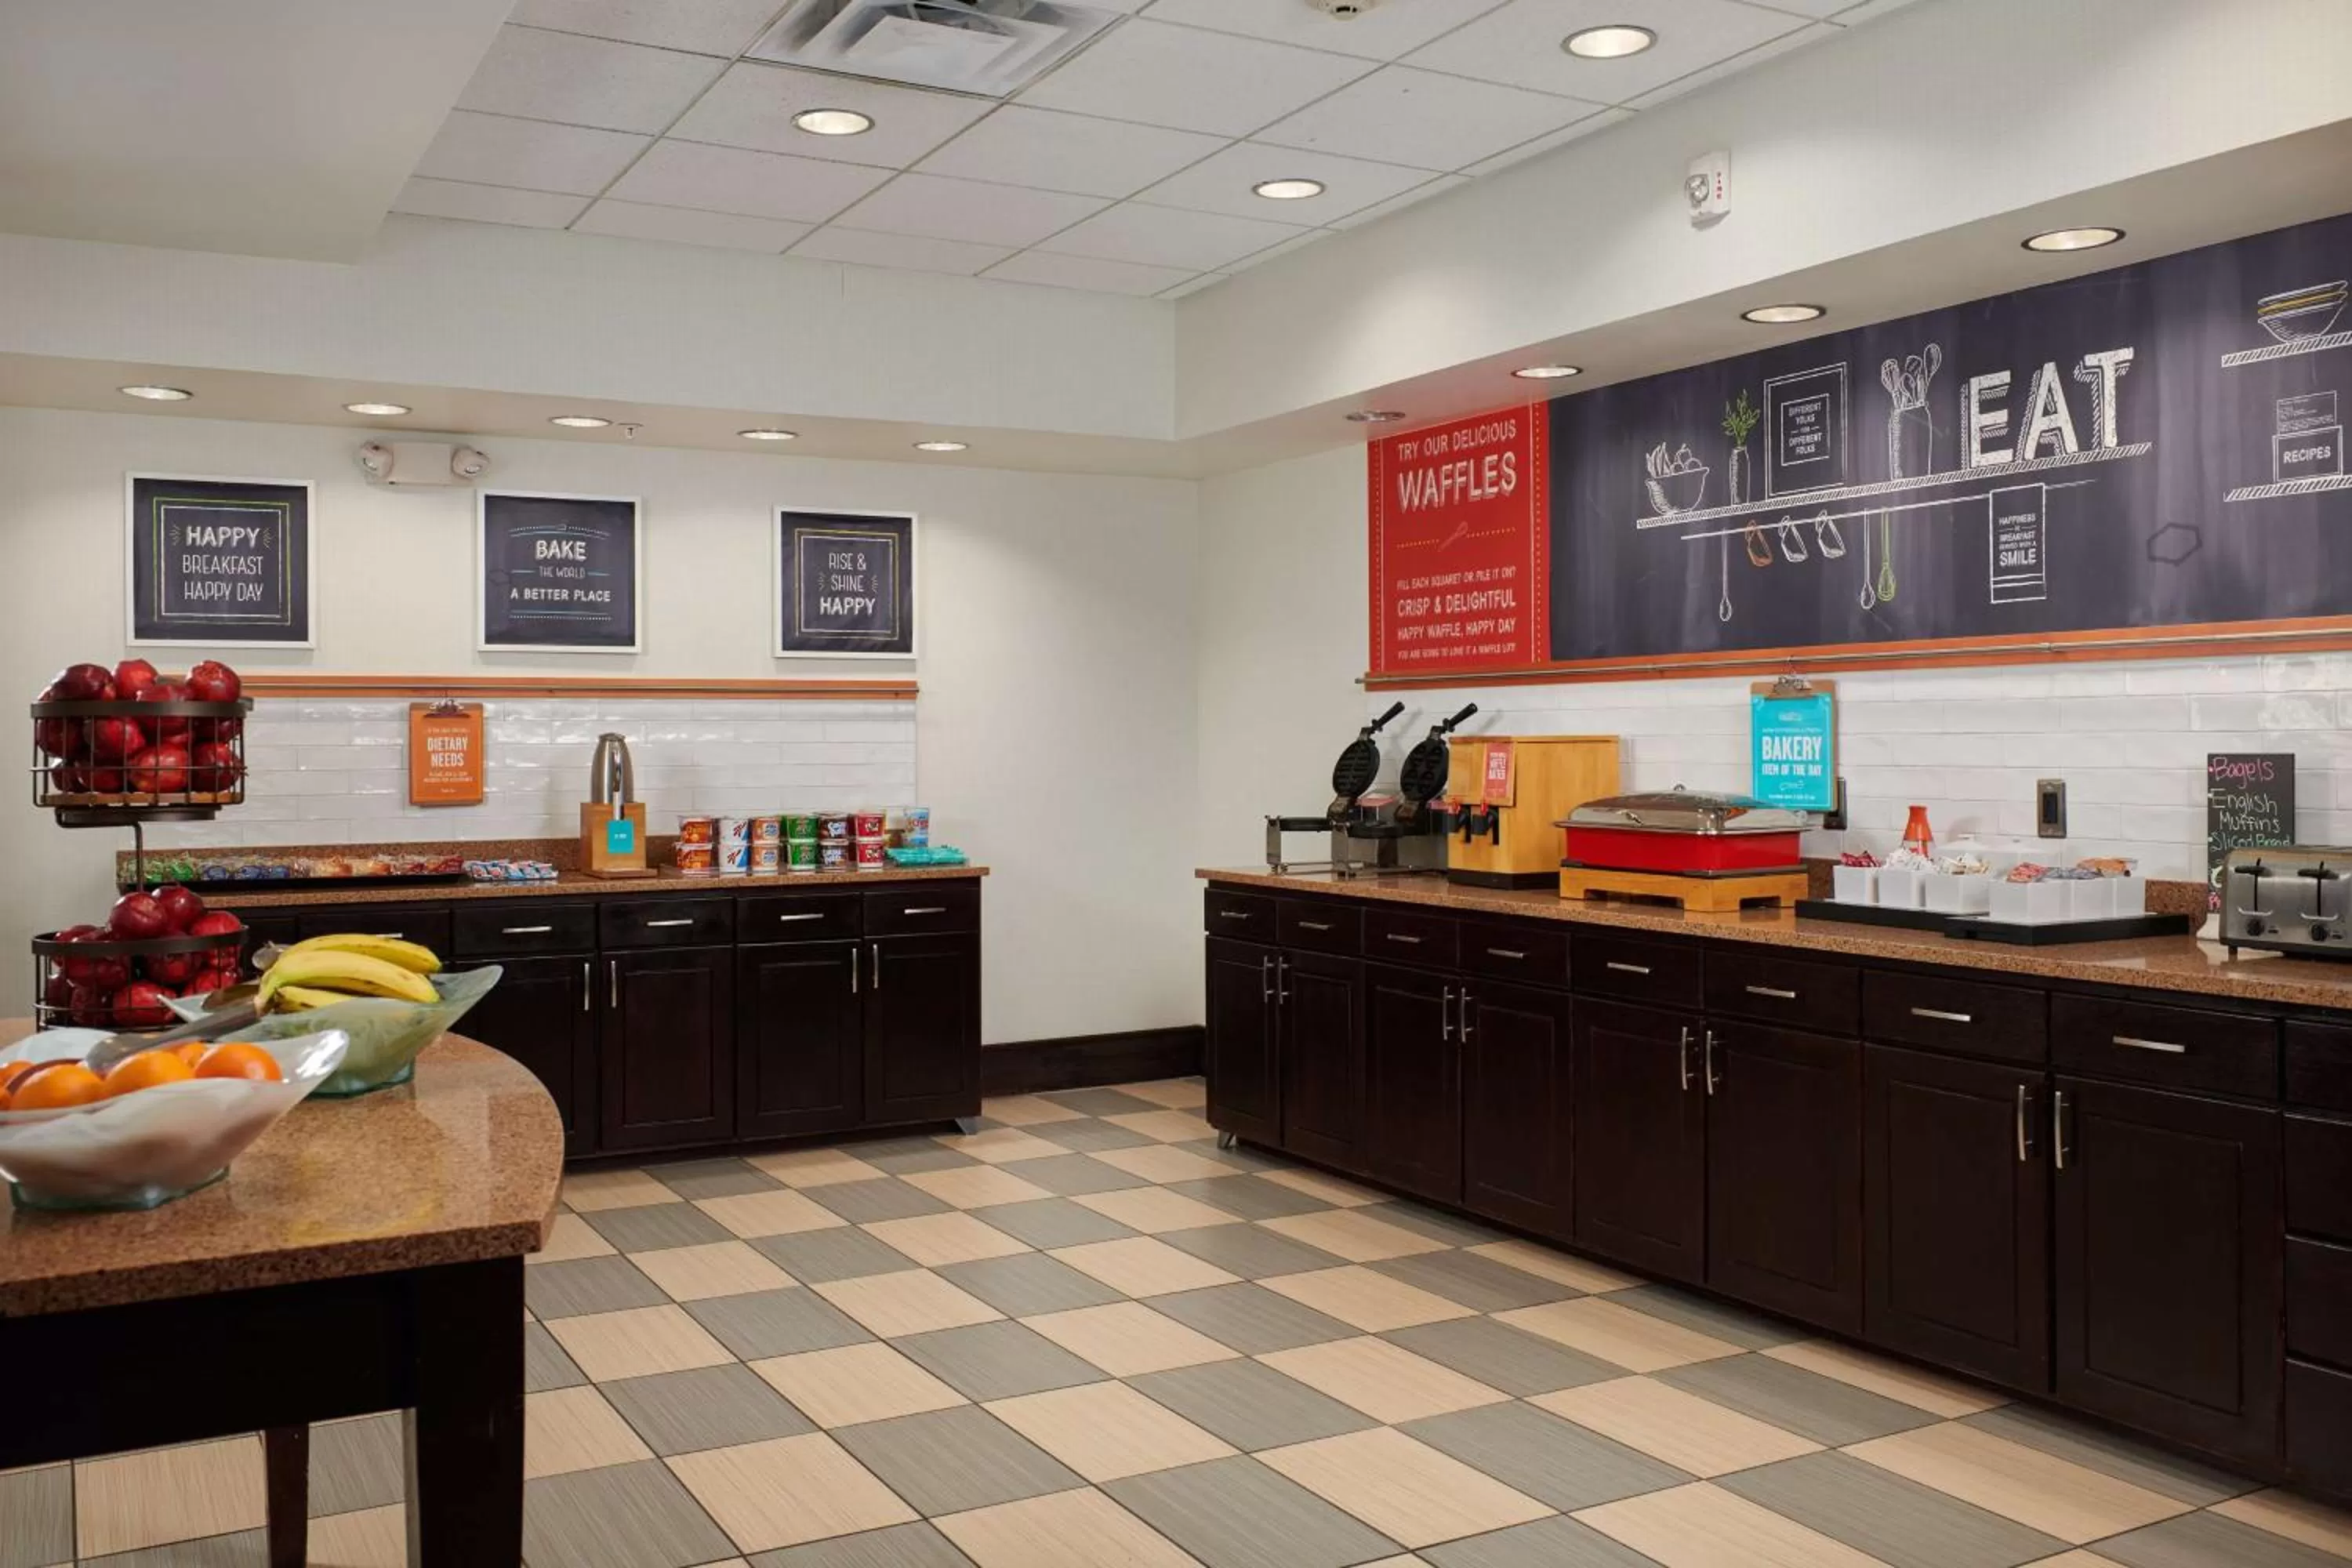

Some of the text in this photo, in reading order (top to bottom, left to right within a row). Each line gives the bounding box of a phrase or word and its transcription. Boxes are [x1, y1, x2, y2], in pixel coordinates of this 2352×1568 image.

[1962, 347, 2134, 470] EAT
[1398, 419, 1516, 461] TRY OUR DELICIOUS
[1788, 432, 1822, 447] DIFFERENT
[2283, 445, 2331, 464] RECIPES
[1398, 451, 1517, 514] WAFFLES
[1998, 513, 2036, 526] HAPPINESS
[186, 525, 260, 548] HAPPY
[535, 539, 587, 561] BAKE
[1999, 549, 2037, 567] SMILE
[183, 554, 263, 575] BREAKFAST
[829, 552, 866, 571] RISE &
[539, 565, 586, 579] THE WORLD
[184, 581, 263, 601] HAPPY DAY
[831, 575, 864, 592] SHINE
[510, 587, 611, 601] A BETTER PLACE
[1398, 587, 1517, 618] CRISP & DELIGHTFUL
[819, 597, 876, 616] HAPPY
[1398, 617, 1516, 641] HAPPY WAFFLE, HAPPY DAY
[427, 736, 468, 752] DIETARY
[1762, 735, 1822, 761] BAKERY
[431, 753, 464, 768] NEEDS
[1762, 764, 1823, 776] ITEM OF THE DAY
[2213, 757, 2274, 789] Bagels
[2210, 788, 2278, 816] English
[2220, 810, 2281, 833] Muffins
